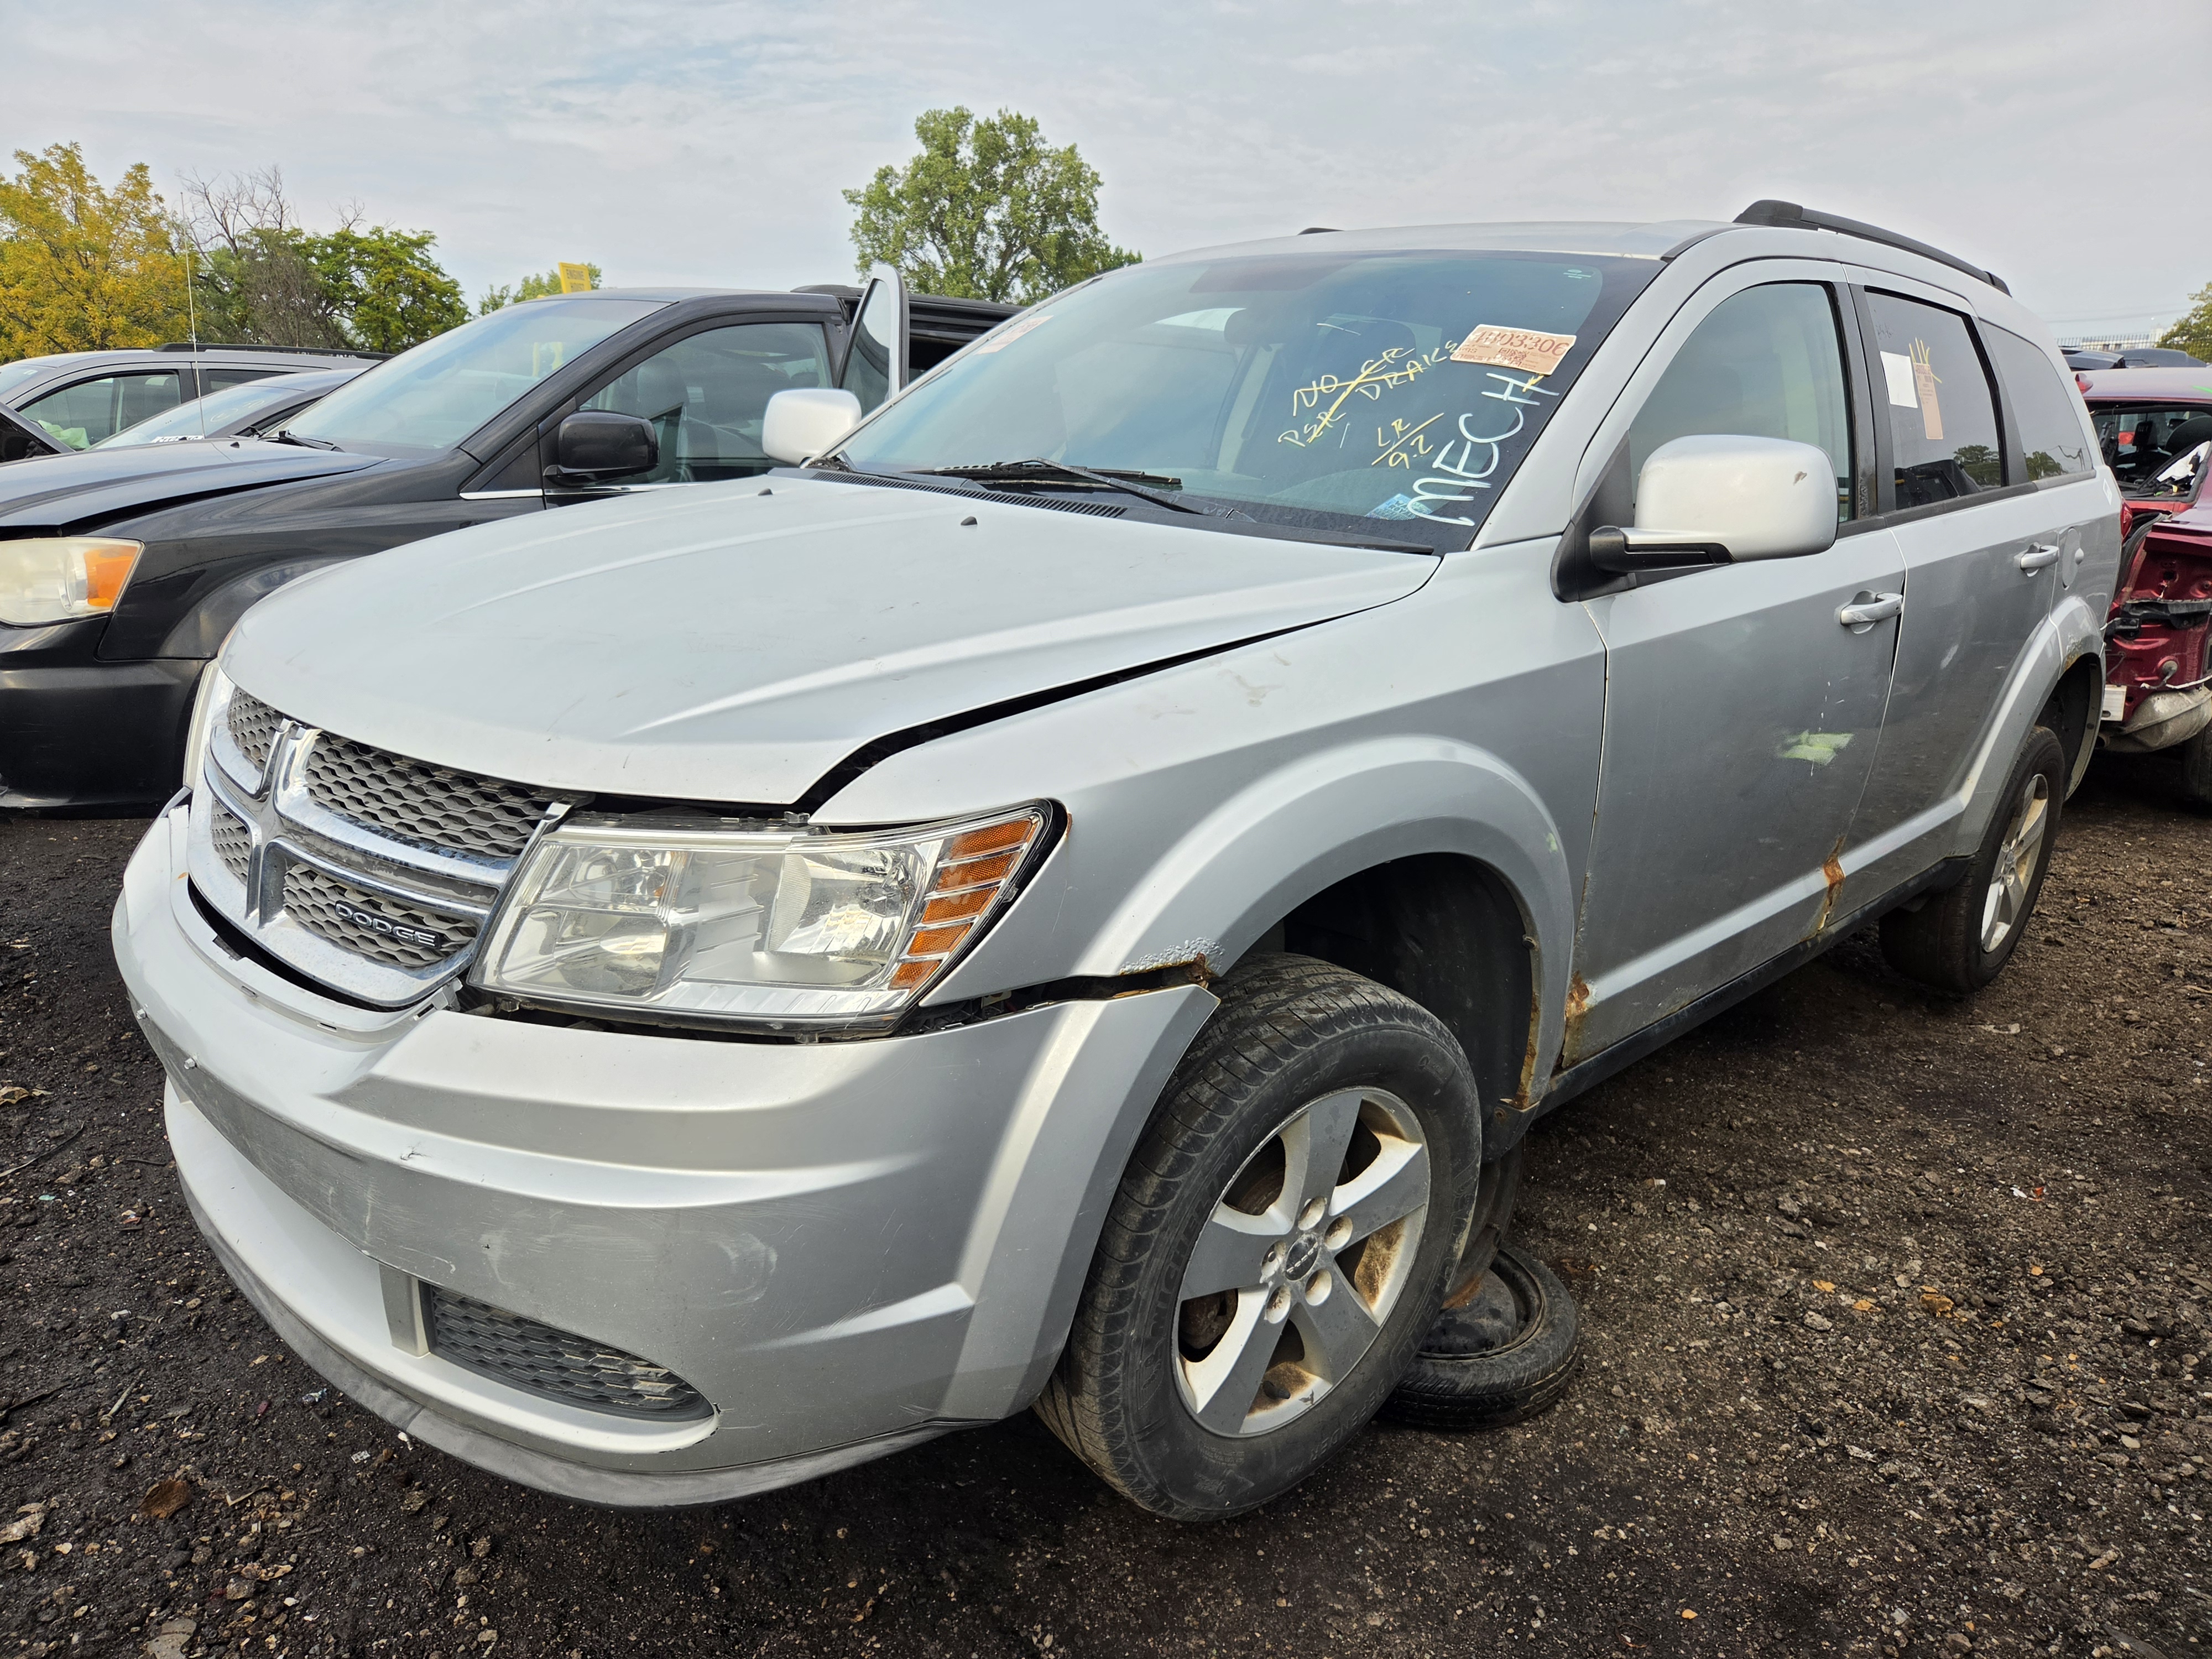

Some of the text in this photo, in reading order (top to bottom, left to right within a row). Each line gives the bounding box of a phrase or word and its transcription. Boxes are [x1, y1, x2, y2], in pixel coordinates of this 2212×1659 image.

[1293, 374, 1338, 416] NO
[1408, 373, 1559, 526] MECH
[336, 902, 436, 947] DODGE
[1309, 1378, 1389, 1465] DEFENDER
